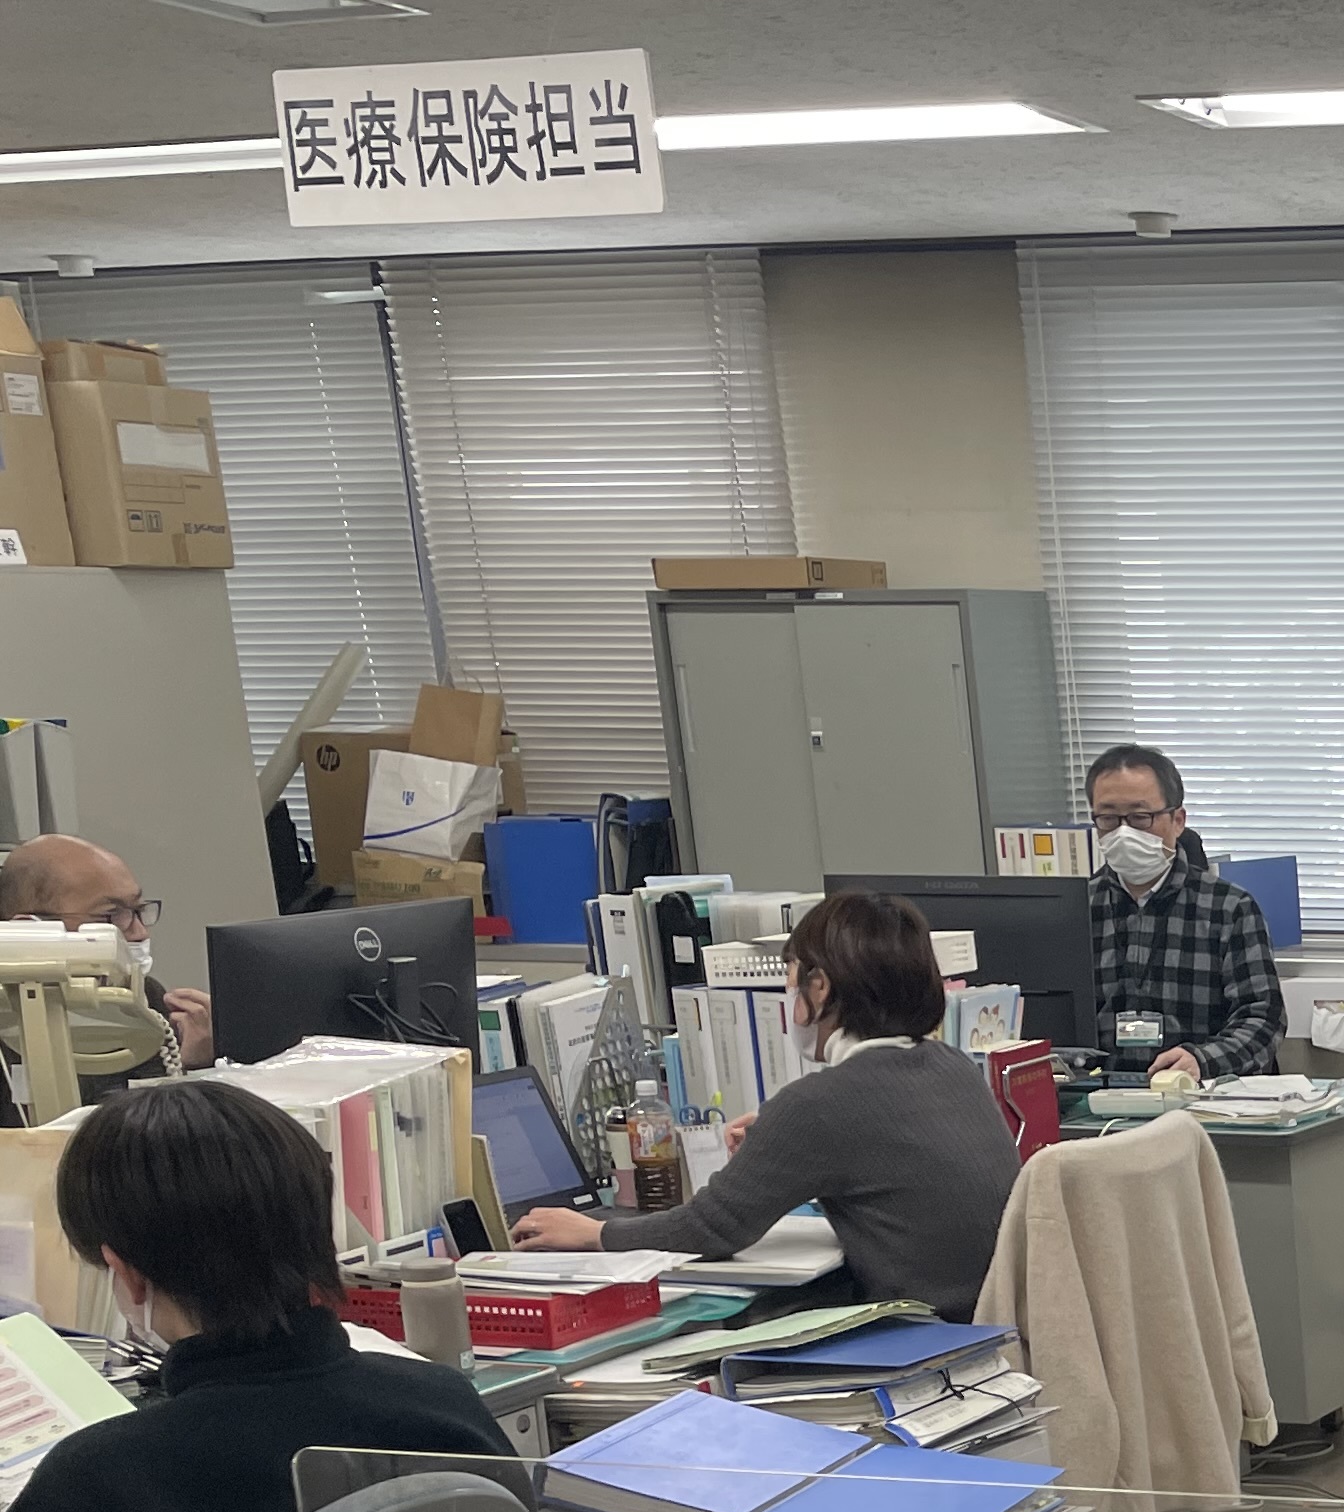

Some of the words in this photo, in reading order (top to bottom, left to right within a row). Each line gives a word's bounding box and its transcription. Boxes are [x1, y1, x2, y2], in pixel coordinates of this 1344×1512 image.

[284, 80, 642, 191] 医療保険担当
[320, 745, 337, 771] hp
[358, 939, 379, 951] DELL
